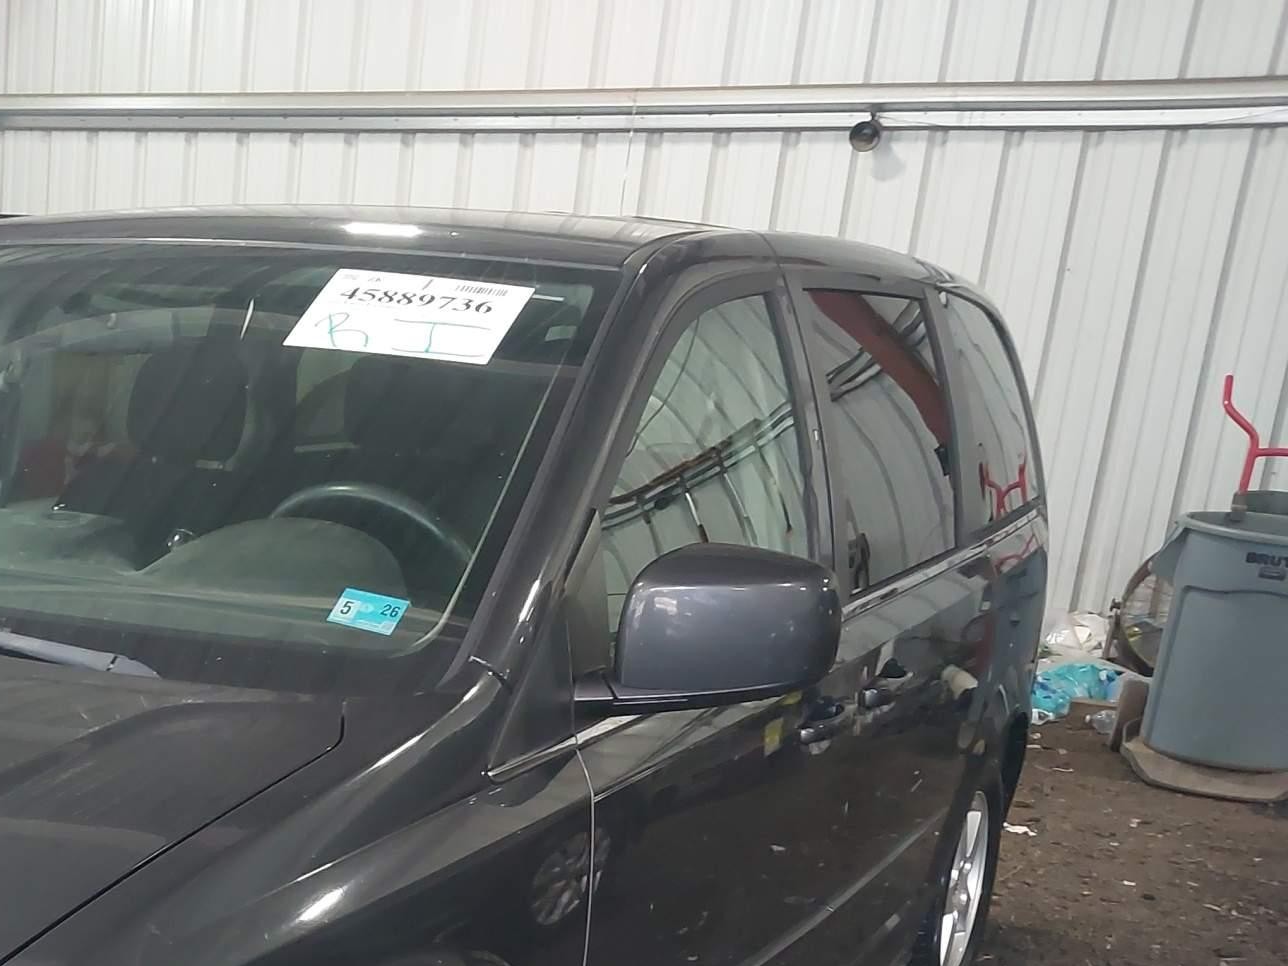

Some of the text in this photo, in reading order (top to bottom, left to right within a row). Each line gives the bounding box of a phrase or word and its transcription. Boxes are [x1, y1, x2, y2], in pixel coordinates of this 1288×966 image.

[340, 286, 493, 315] 45889736
[340, 600, 401, 618] 5 26
